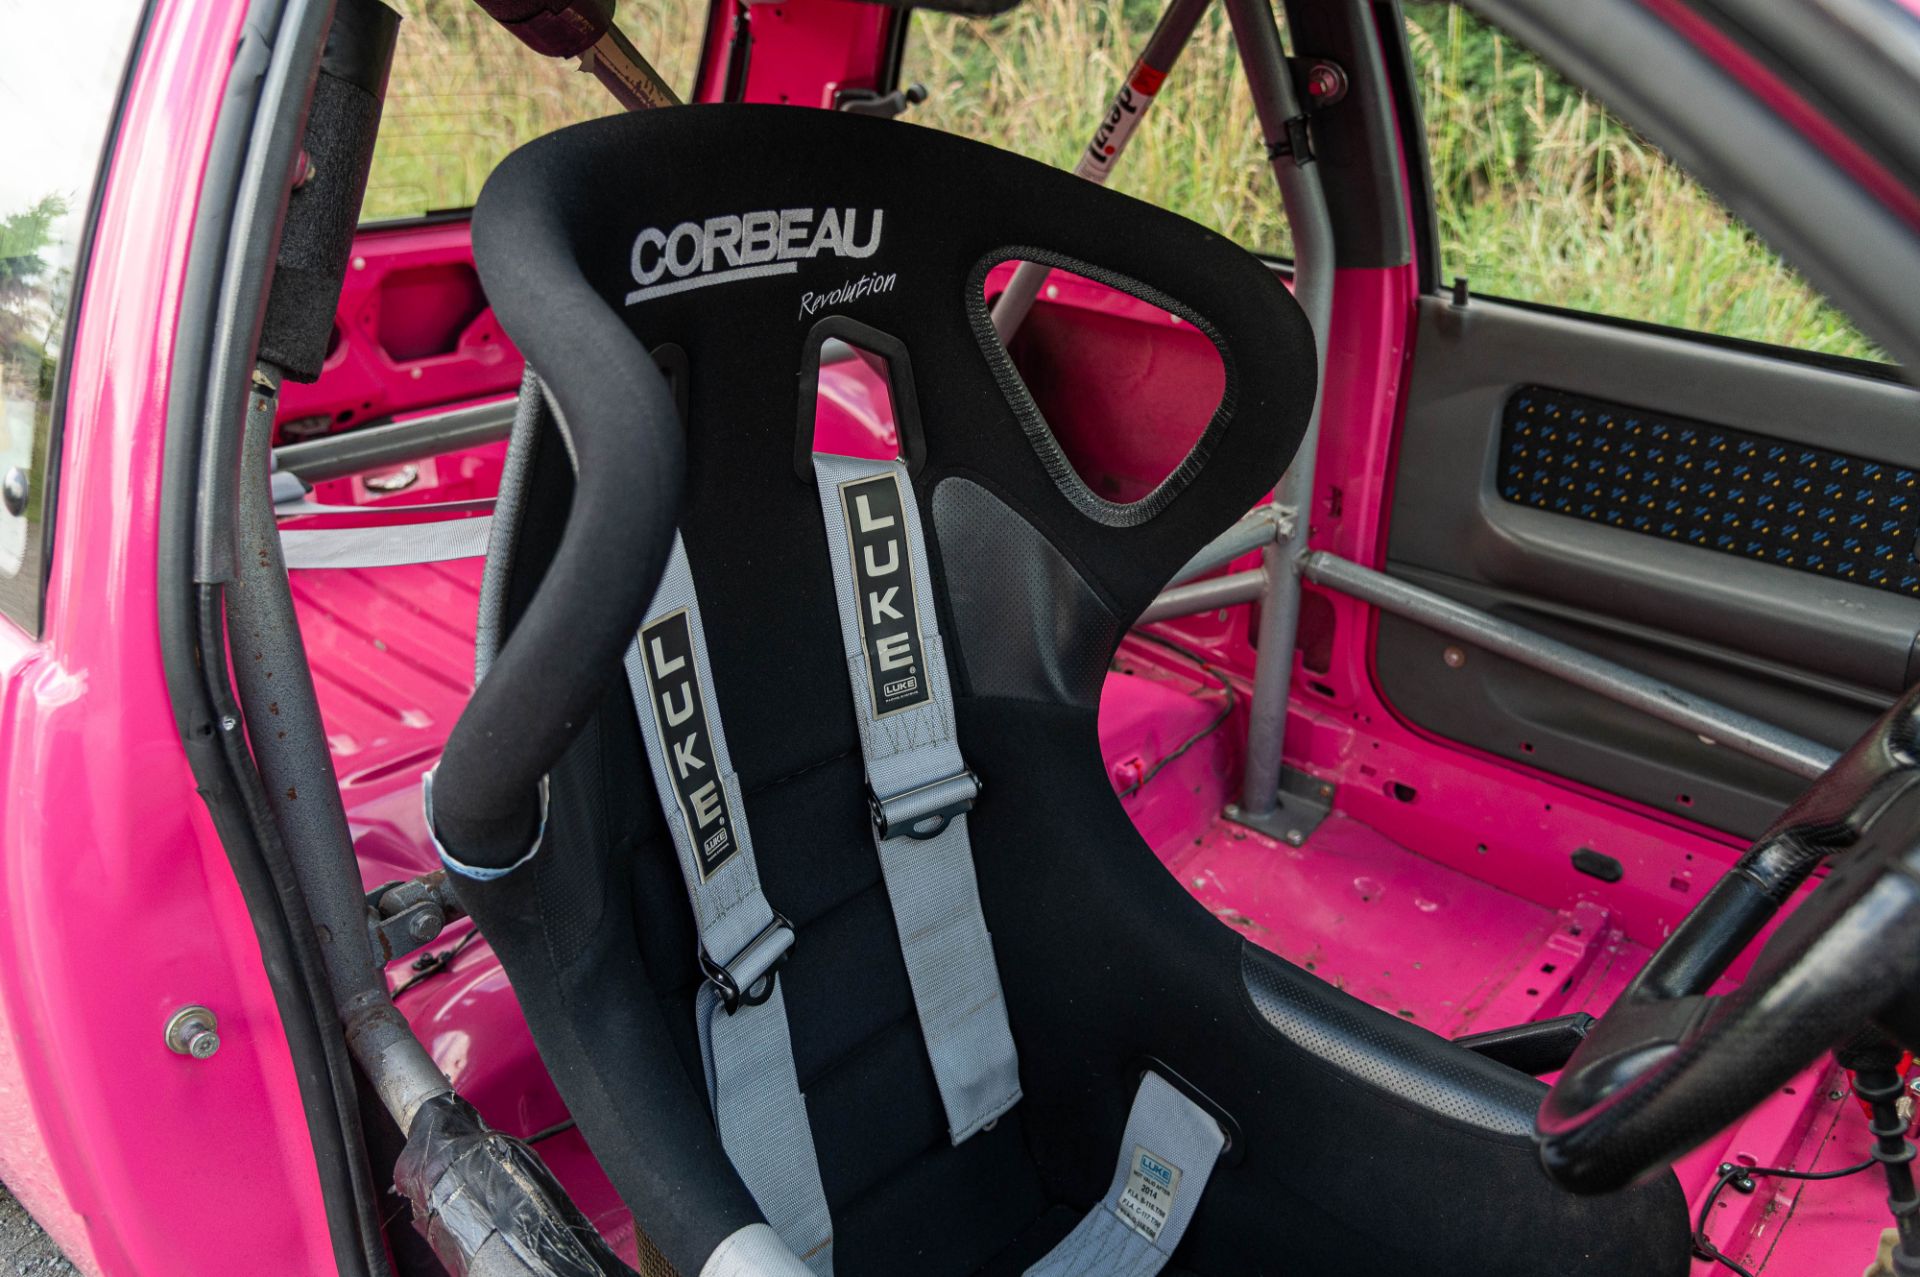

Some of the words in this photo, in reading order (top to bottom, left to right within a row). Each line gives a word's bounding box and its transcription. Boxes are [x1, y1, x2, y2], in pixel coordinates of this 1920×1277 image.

[1088, 84, 1137, 163] devil
[630, 208, 883, 285] CORBEAU
[798, 271, 897, 320] Revolution
[855, 494, 914, 672] LUKE
[886, 678, 915, 695] LUKE
[651, 636, 722, 829] LUKE
[705, 831, 727, 852] LUKE
[1142, 1158, 1170, 1178] LUKE
[1143, 1176, 1156, 1187] VALID
[1141, 1184, 1158, 1199] 2014
